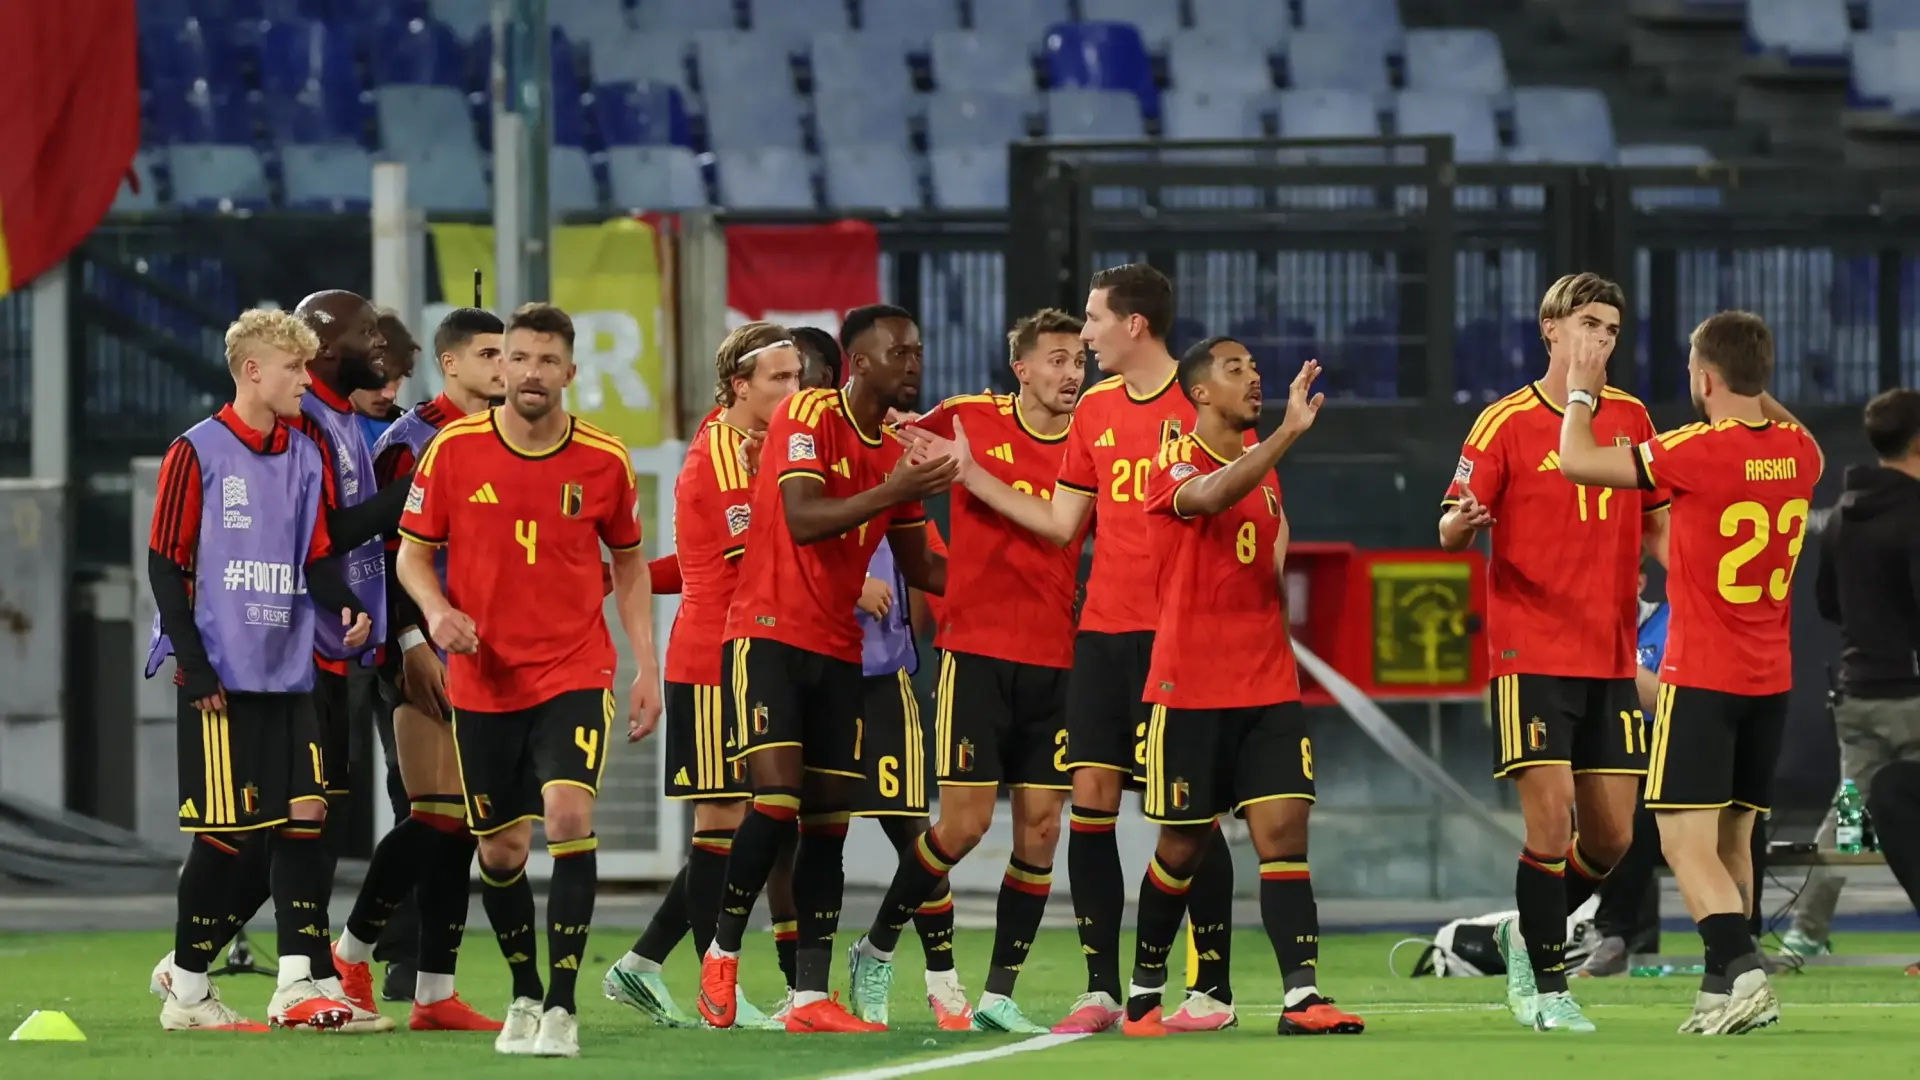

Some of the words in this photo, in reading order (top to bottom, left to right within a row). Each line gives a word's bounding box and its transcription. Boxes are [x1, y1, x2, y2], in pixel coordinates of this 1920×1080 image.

[1111, 457, 1152, 502] 20
[1744, 457, 1797, 481] RASKIN
[1576, 484, 1613, 521] 17
[515, 519, 537, 565] 4
[1236, 521, 1256, 564] 8
[1717, 498, 1809, 604] 23
[263, 609, 291, 624] RESPE
[575, 726, 598, 770] 4
[1620, 710, 1646, 754] 17
[878, 755, 899, 798] 6
[1300, 737, 1313, 780] 8
